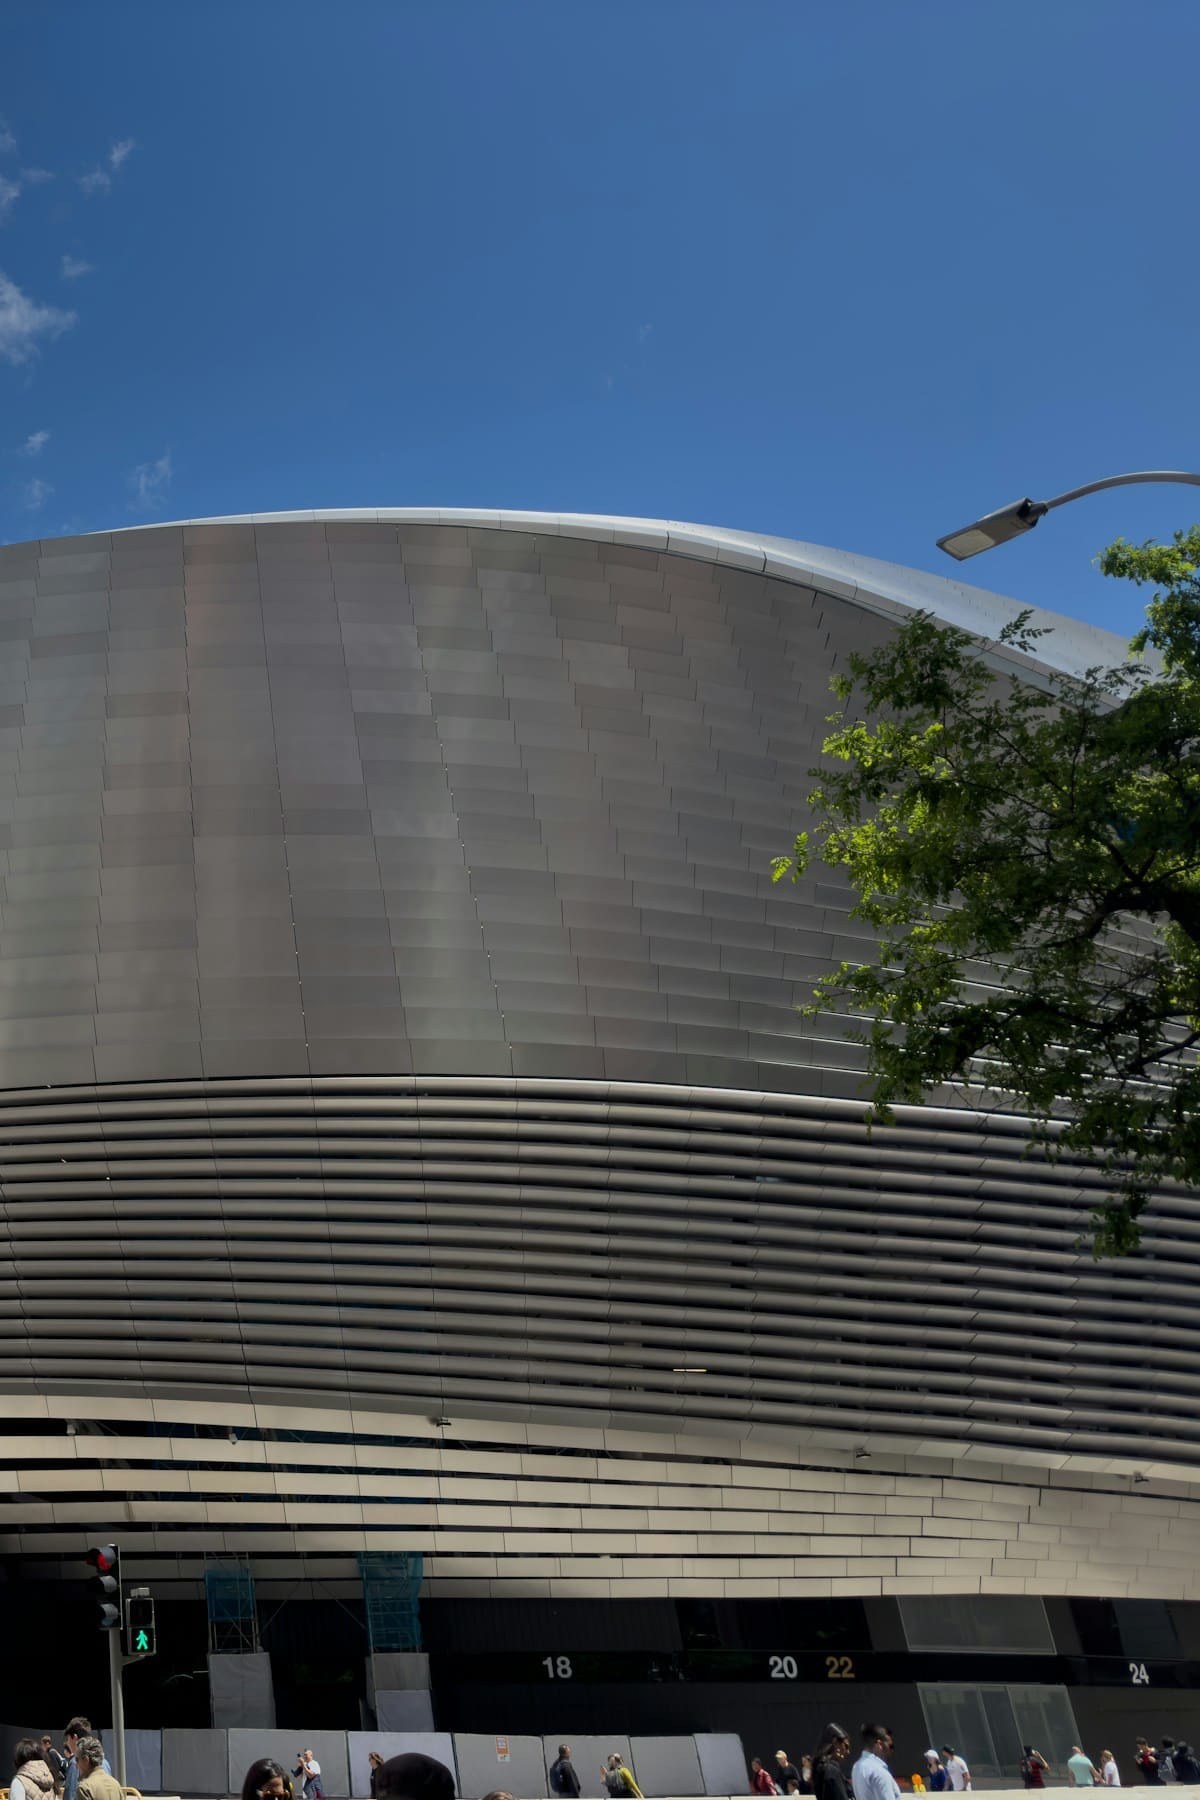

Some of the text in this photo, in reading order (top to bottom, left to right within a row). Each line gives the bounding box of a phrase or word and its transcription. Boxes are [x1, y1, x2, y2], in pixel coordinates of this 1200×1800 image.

[542, 1656, 572, 1678] 18
[769, 1656, 798, 1678] 20
[826, 1656, 855, 1678] 22
[1129, 1663, 1149, 1684] 24
